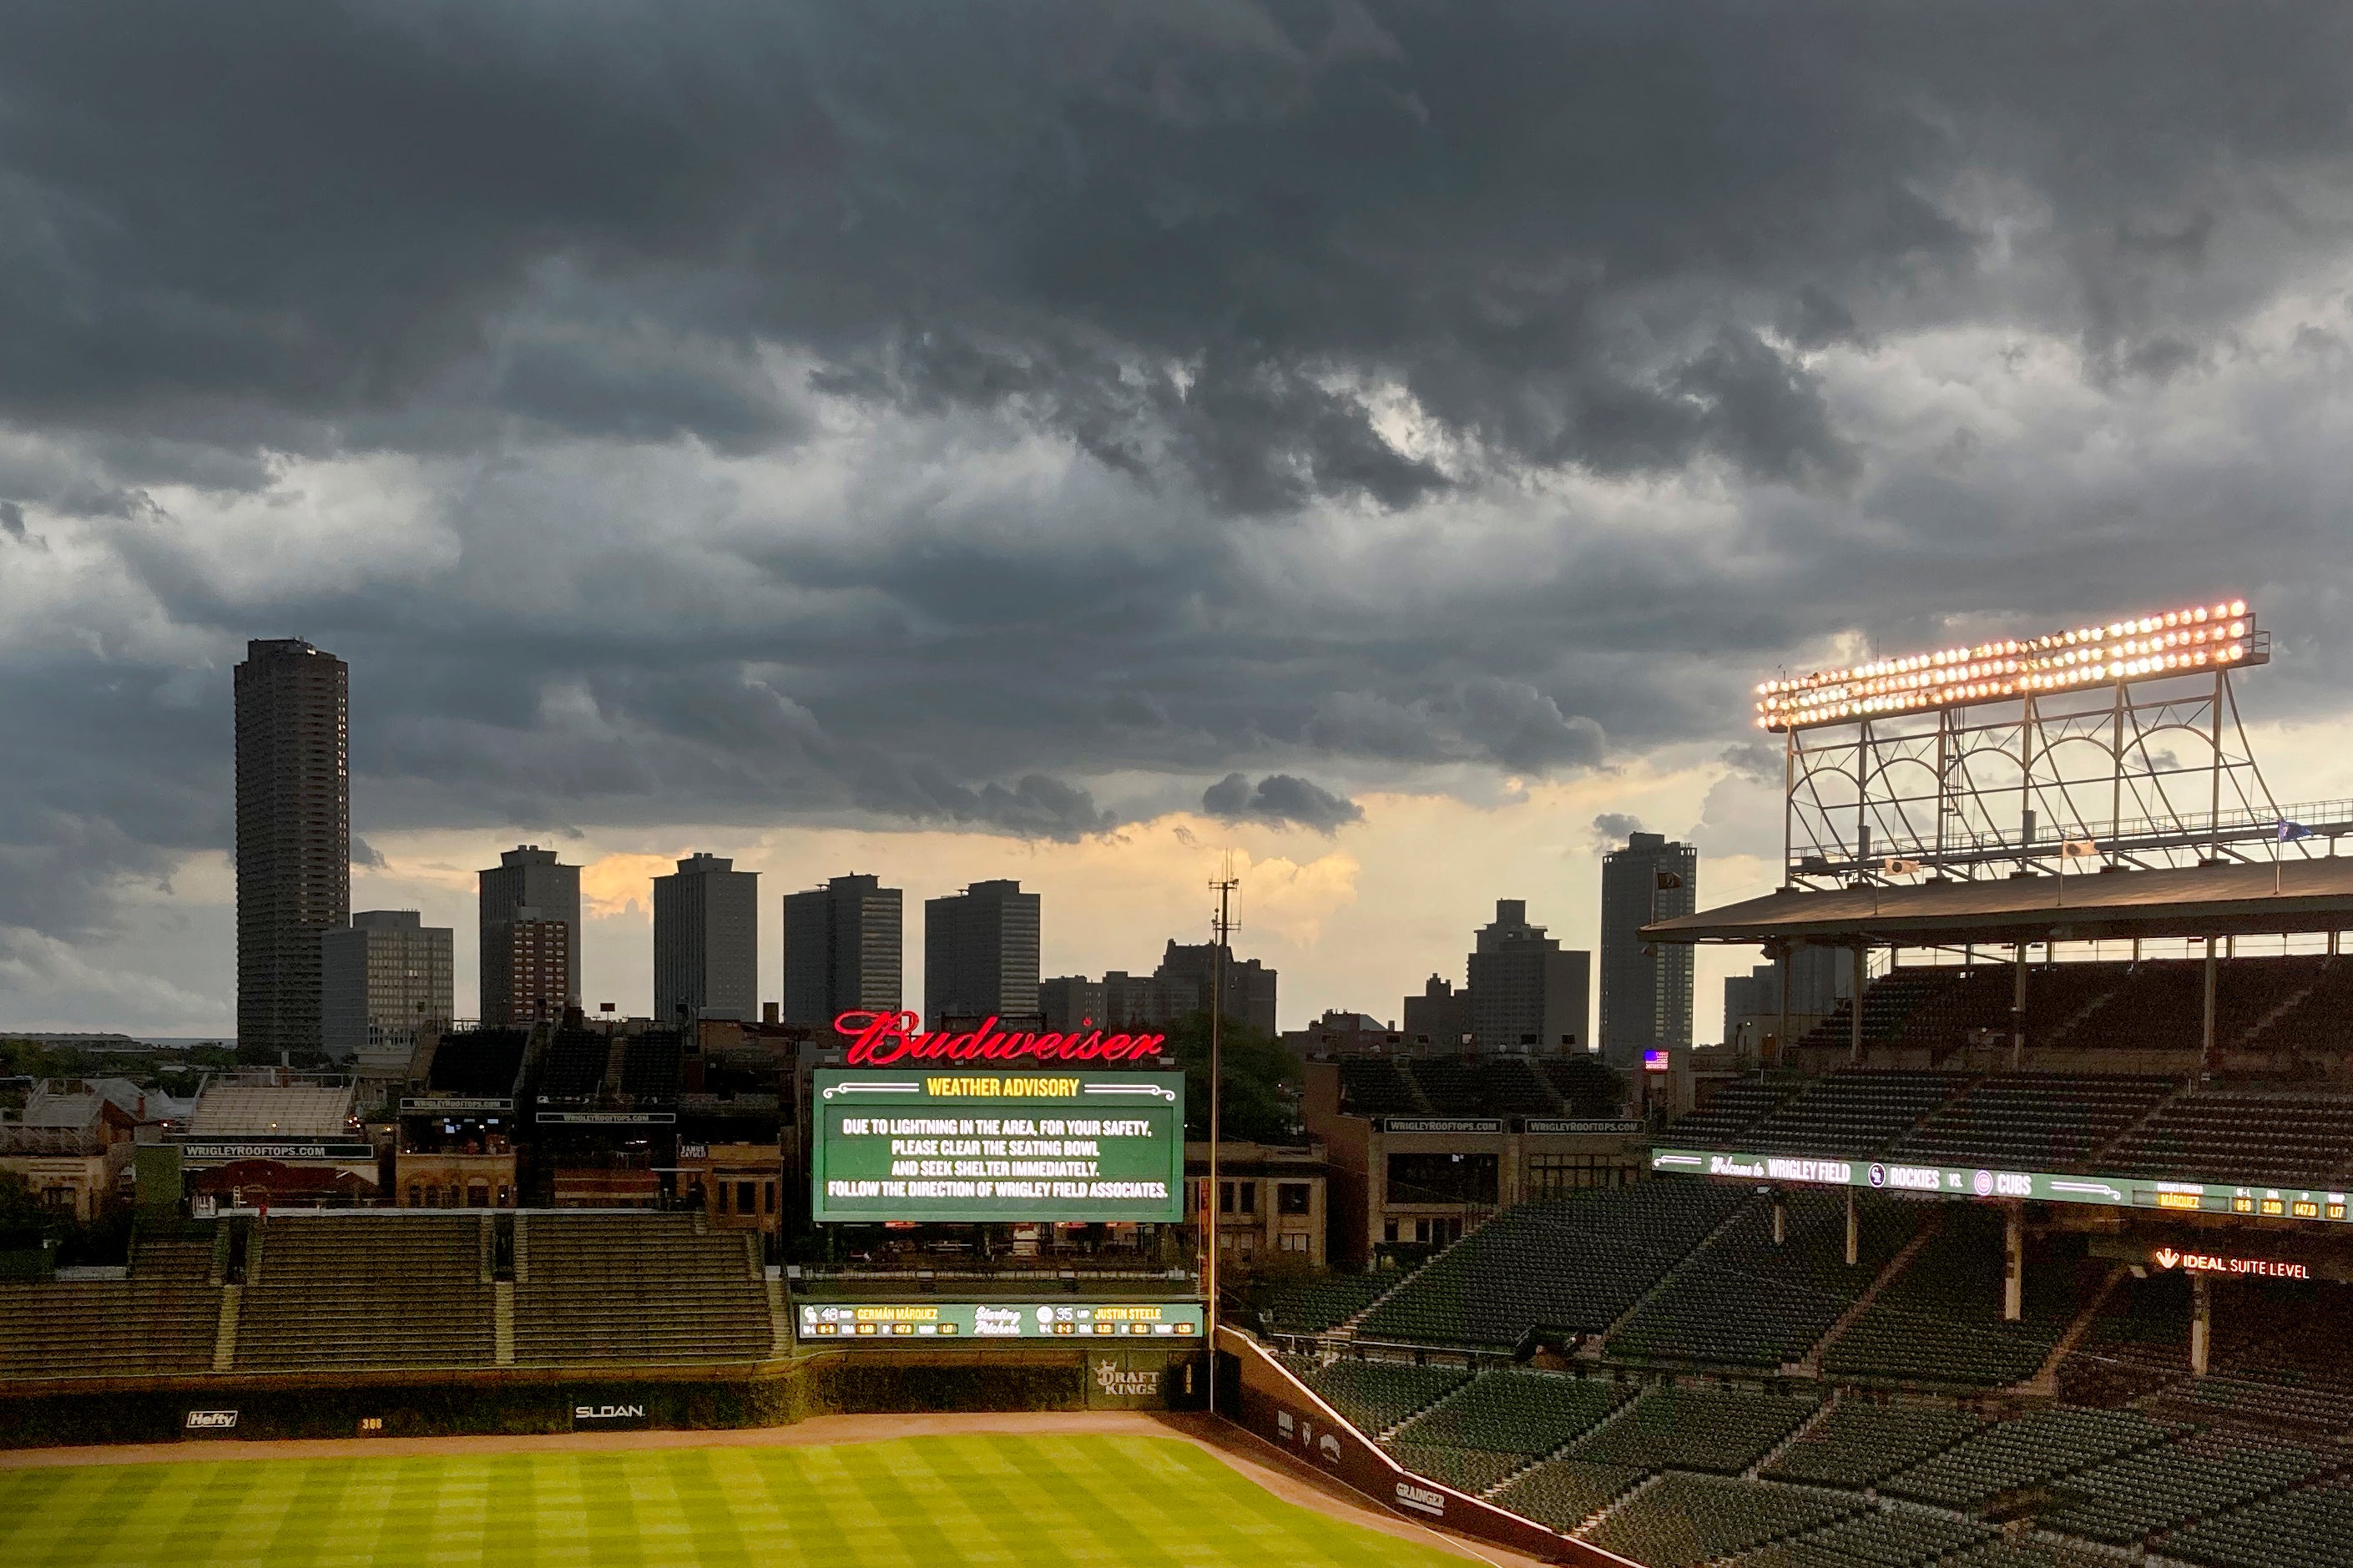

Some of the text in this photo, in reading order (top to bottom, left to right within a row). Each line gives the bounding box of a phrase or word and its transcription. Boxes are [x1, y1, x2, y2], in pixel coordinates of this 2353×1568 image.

[835, 1011, 1164, 1065] Budweiser
[927, 1077, 1079, 1097] WEATHER ADVISORY
[842, 1119, 1152, 1137] DUE TO LIGHTNING IN THE AREA, FOR YOUR SAFETY,
[891, 1140, 1100, 1156] PLEASE CLEAR THE SEATING BOWL
[891, 1161, 1100, 1177] AND SEEK SHELTER IMMEDIATELY.
[1711, 1156, 1851, 1182] Welcome to WRIGLEY FIELD
[1890, 1167, 1940, 1189] ROCKIES
[1949, 1173, 1963, 1187] VS.
[1997, 1173, 2032, 1195] CUBS
[828, 1181, 1169, 1197] FOLLOW THE DIRECTION OF WRIGLEY FIELD ASSOCIATES.
[2161, 1192, 2199, 1208] MÁRQUEZ
[2263, 1201, 2282, 1214] 3.80
[2295, 1203, 2316, 1217] 147.0
[2183, 1254, 2310, 1279] IDEAL SUITE LEVEL
[821, 1308, 838, 1321] 48
[857, 1306, 895, 1320] GERMÁN
[896, 1306, 938, 1320] MÁRQUEZ
[974, 1305, 1022, 1325] Starting
[1056, 1307, 1073, 1320] 35
[1094, 1308, 1128, 1319] JUSTIN
[1129, 1308, 1162, 1319] STEELE
[973, 1320, 1021, 1334] Pitchers
[1095, 1371, 1159, 1386] DRAFT
[1104, 1384, 1158, 1395] KINGS
[190, 1413, 235, 1425] Hefty
[575, 1404, 643, 1419] SLOAN
[1396, 1482, 1445, 1508] GRAINGER
